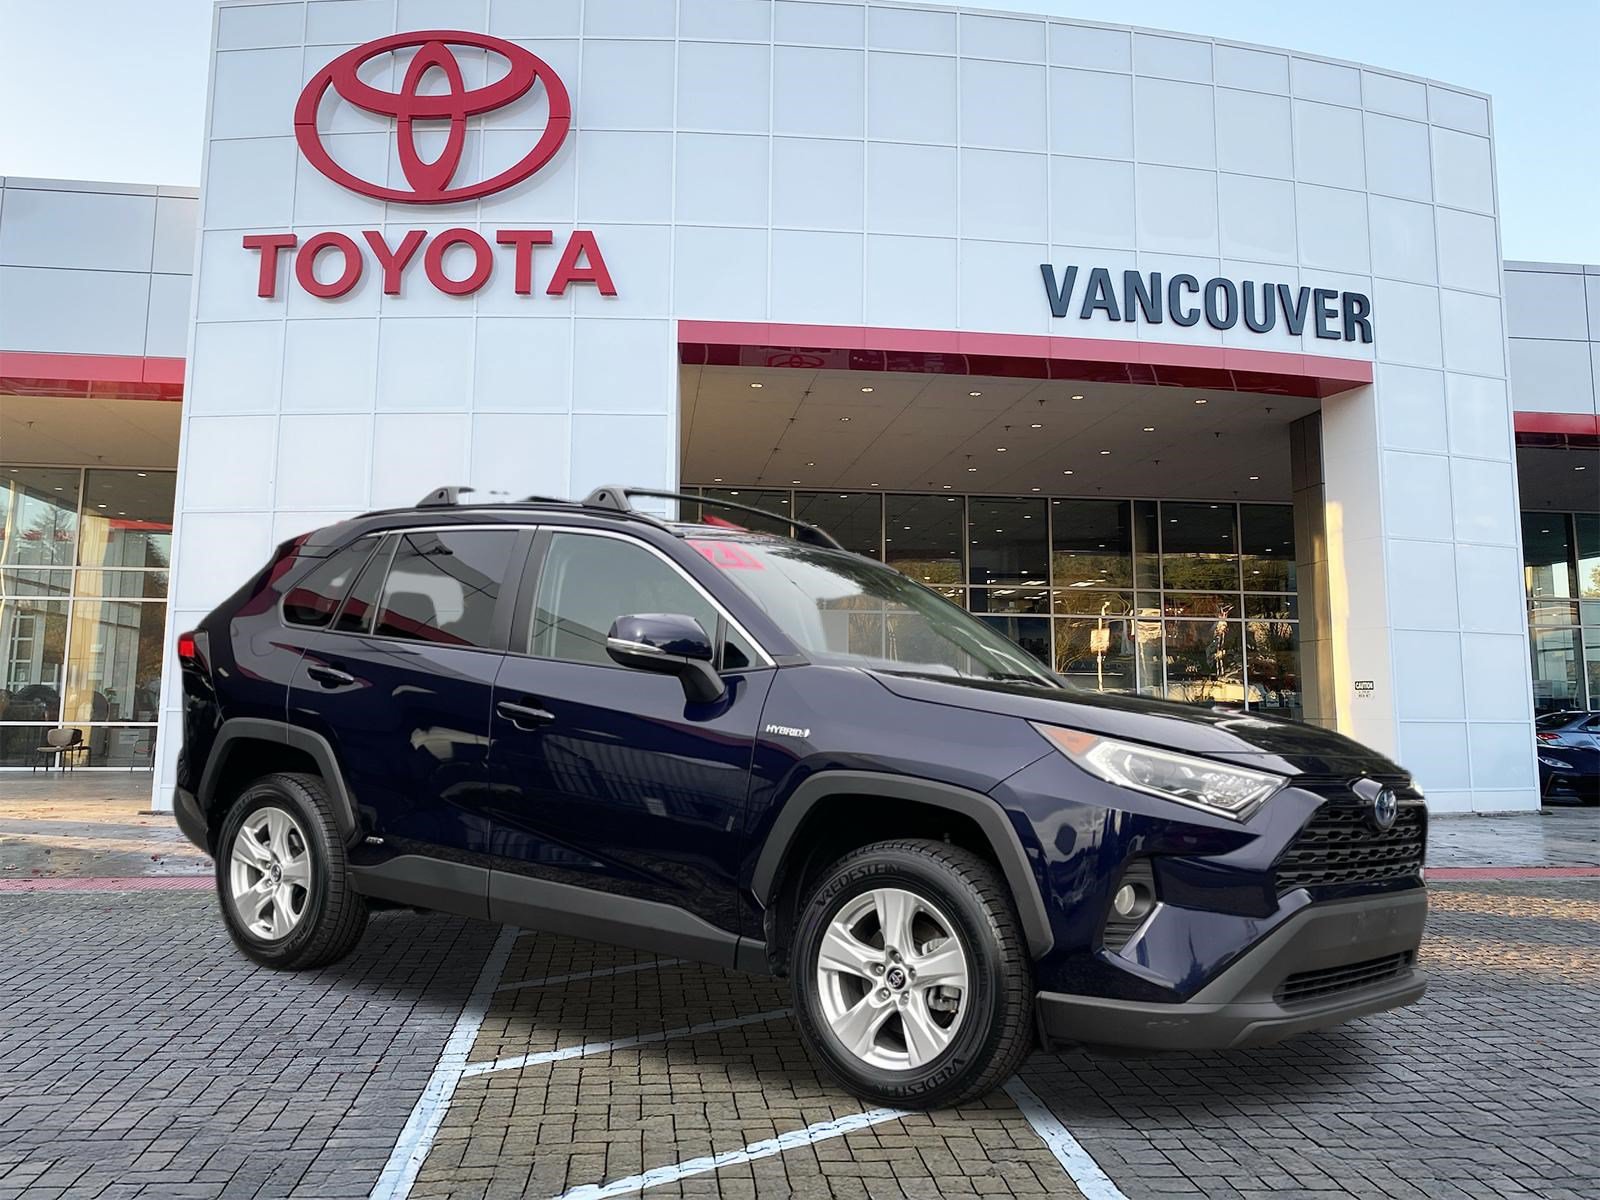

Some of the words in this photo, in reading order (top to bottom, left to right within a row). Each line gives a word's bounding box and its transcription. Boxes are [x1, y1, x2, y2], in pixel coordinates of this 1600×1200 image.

[243, 228, 618, 298] TOYOTA
[1040, 264, 1373, 343] VANCOUVER
[765, 724, 803, 737] HYBRID
